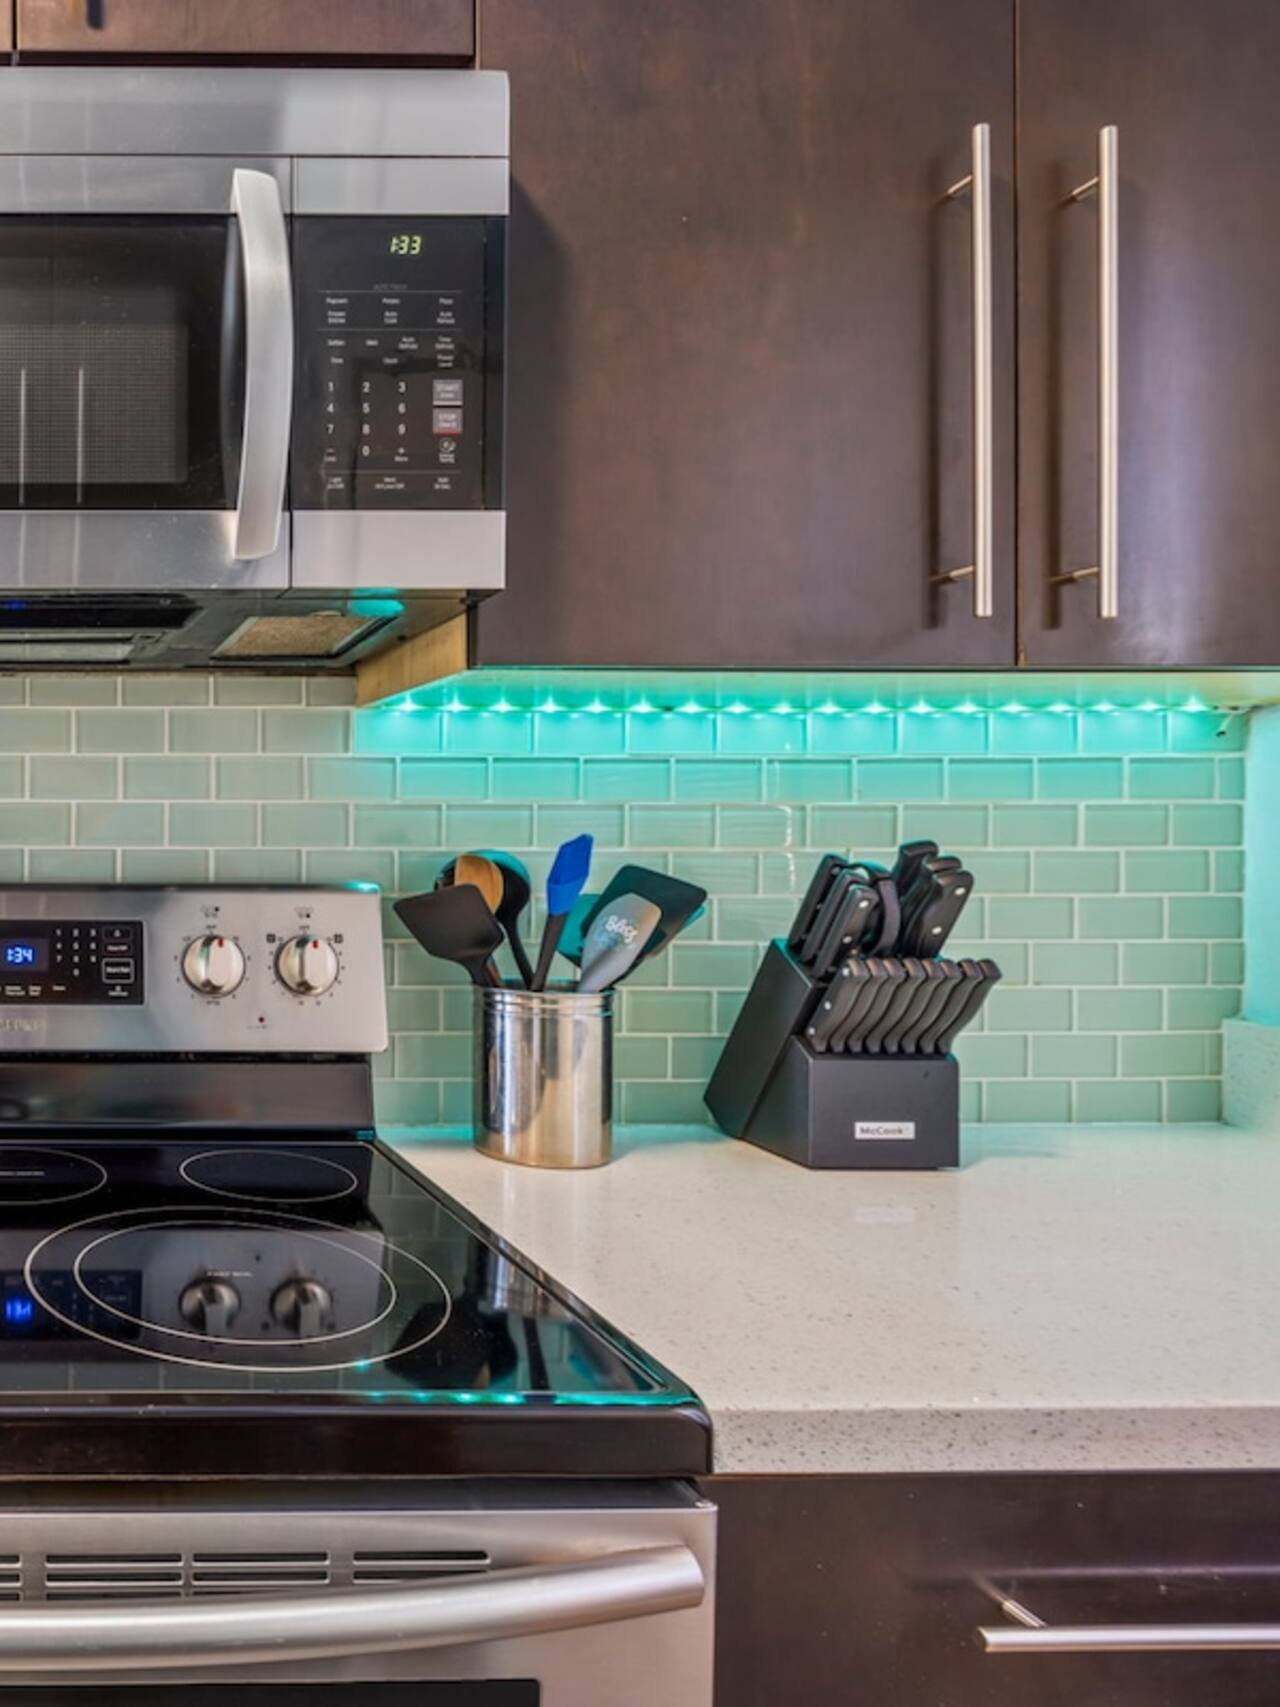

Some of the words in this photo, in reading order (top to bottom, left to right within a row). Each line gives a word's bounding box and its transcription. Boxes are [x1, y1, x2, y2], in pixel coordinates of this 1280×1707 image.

[389, 236, 422, 255] 1:33
[327, 381, 335, 393] 1
[362, 381, 370, 393] 2
[398, 381, 406, 393] 3
[327, 403, 335, 414] 4
[362, 403, 370, 414] 5
[398, 403, 406, 414] 6
[327, 424, 335, 435] 7
[362, 424, 370, 435] 8
[398, 424, 406, 435] 9
[362, 445, 370, 457] 0
[860, 1126, 903, 1136] McCook
